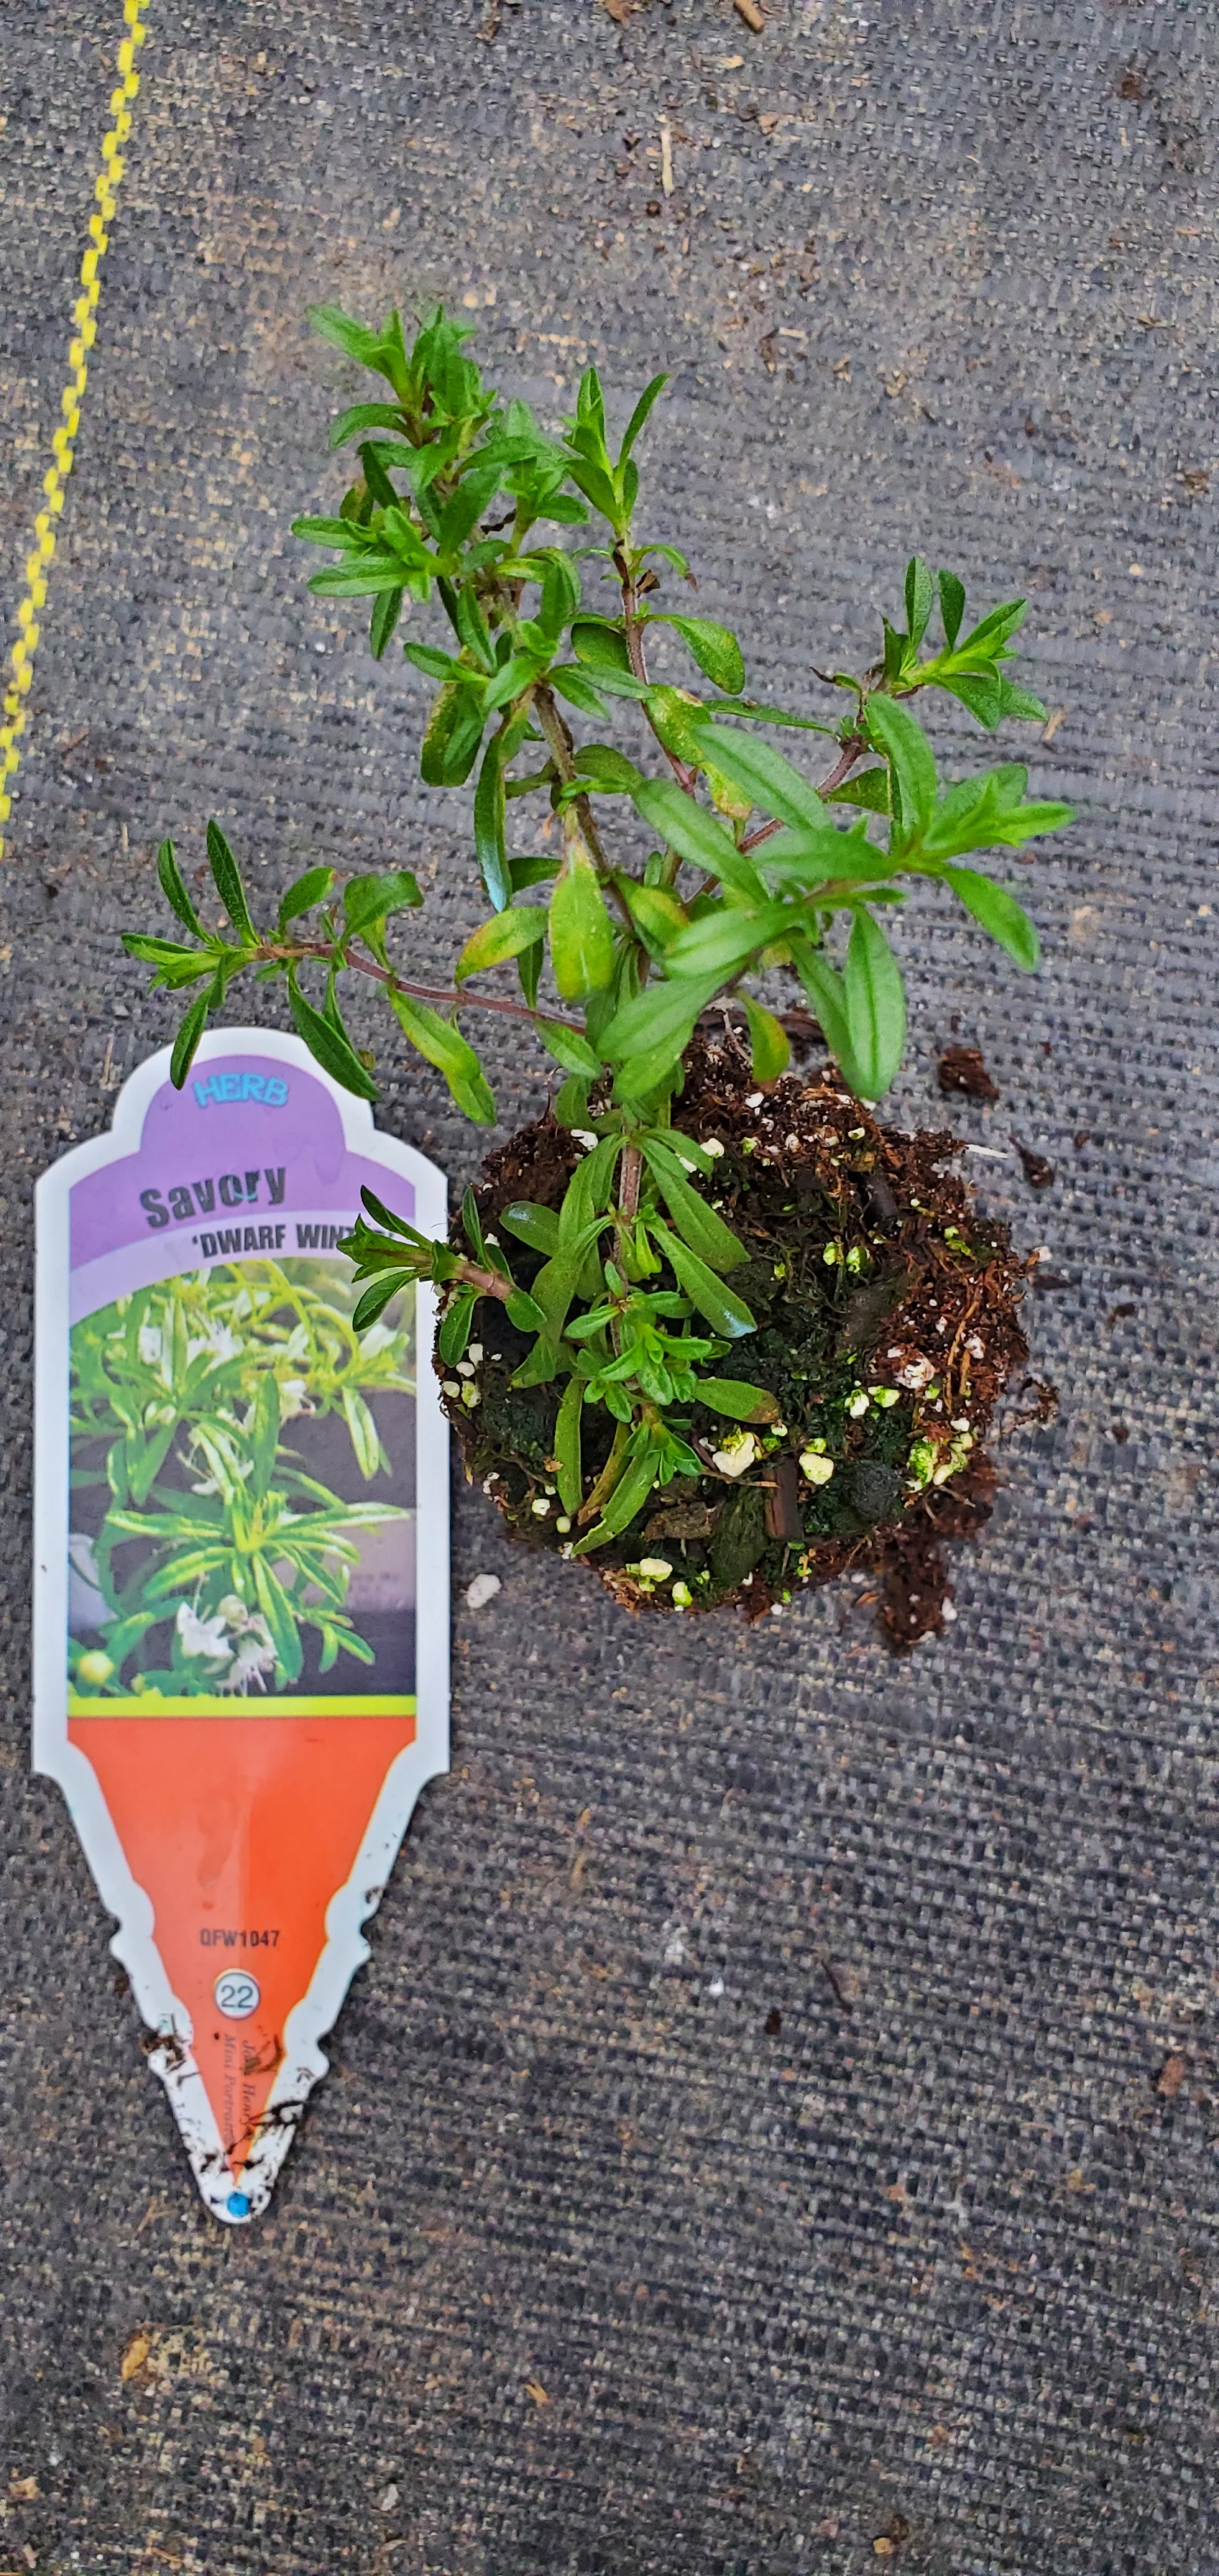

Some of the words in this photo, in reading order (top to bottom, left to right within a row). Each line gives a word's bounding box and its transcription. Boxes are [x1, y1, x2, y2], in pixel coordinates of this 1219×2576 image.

[194, 1073, 288, 1107] HERB
[139, 1167, 287, 1228] Savory
[200, 1928, 280, 1947] QFW1047
[221, 1984, 254, 2008] 22
